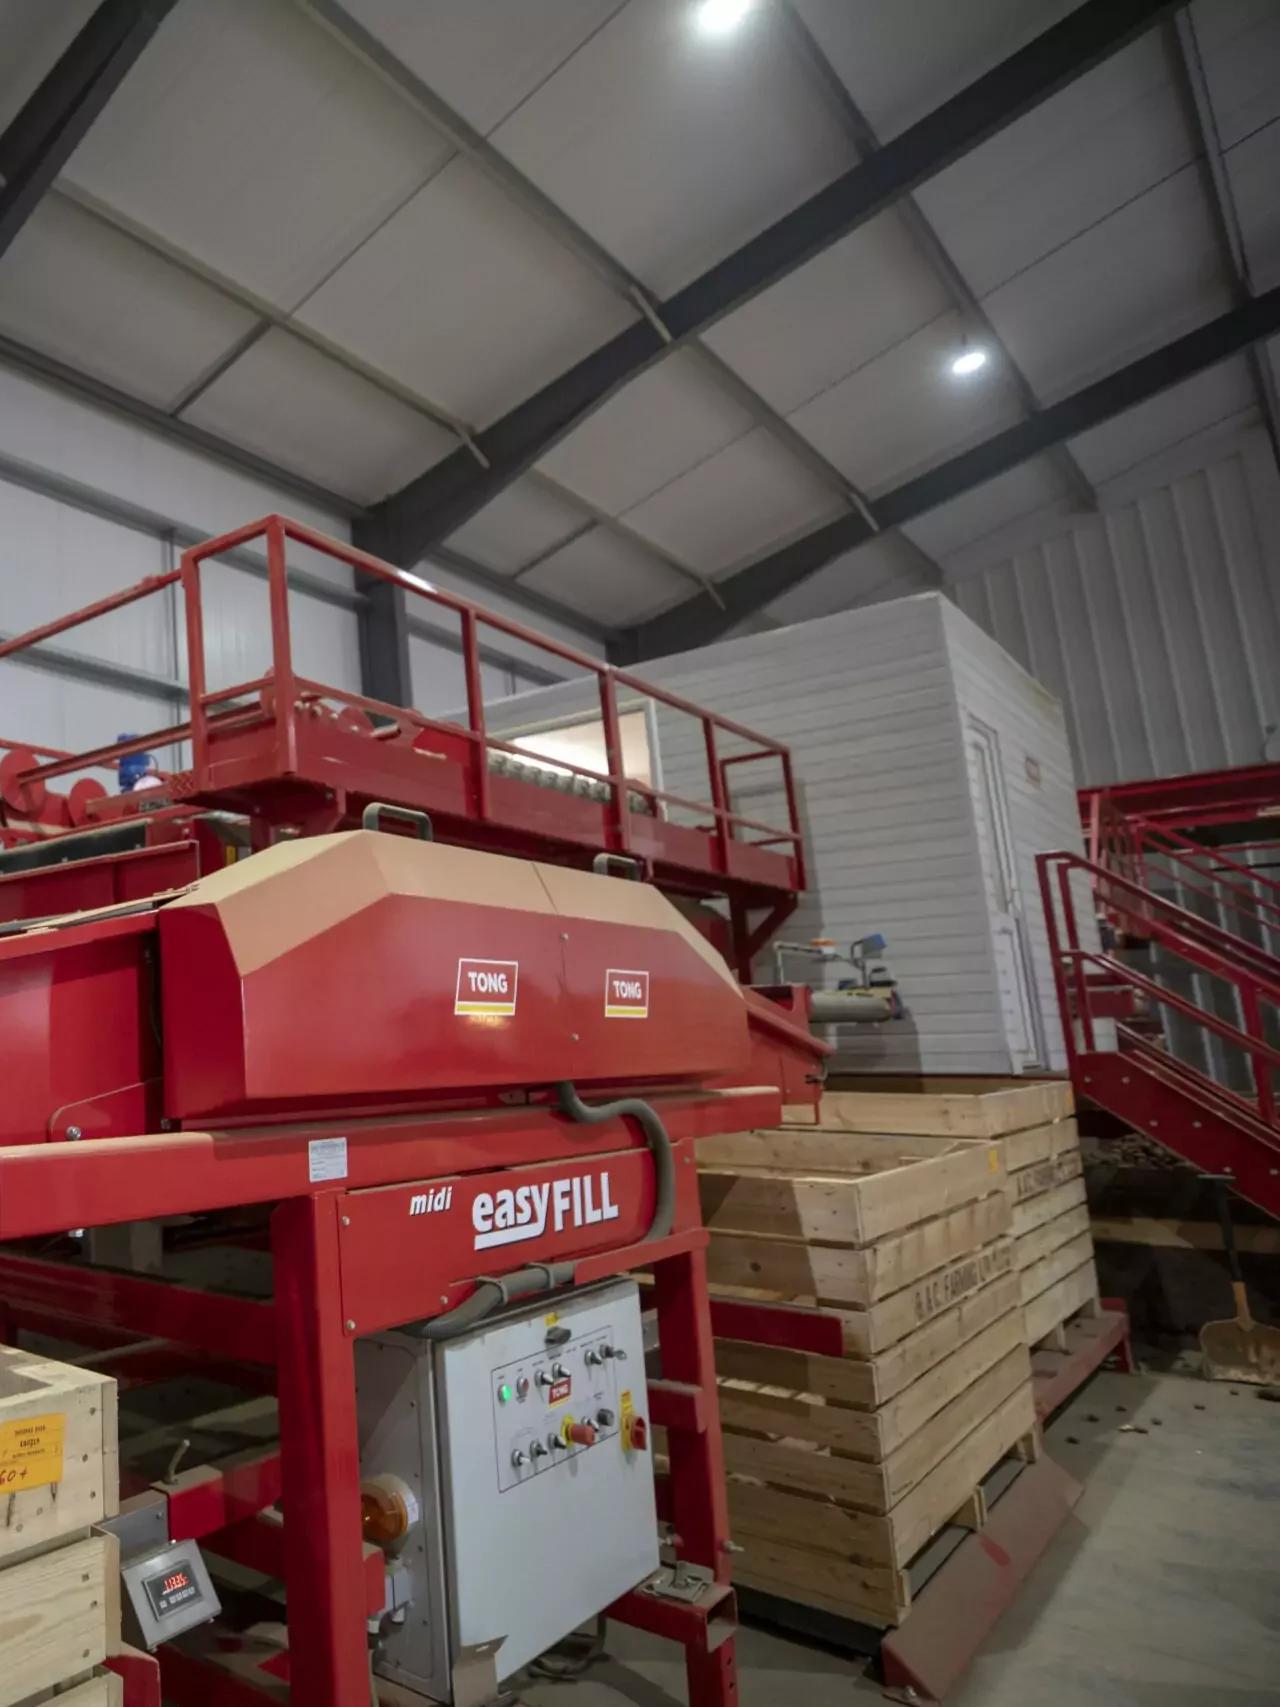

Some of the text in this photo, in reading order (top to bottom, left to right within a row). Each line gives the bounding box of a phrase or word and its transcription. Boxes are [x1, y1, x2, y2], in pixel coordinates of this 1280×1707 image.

[468, 971, 508, 994] TONG
[613, 980, 642, 999] TONG
[409, 1171, 619, 1251] midi easyFILL
